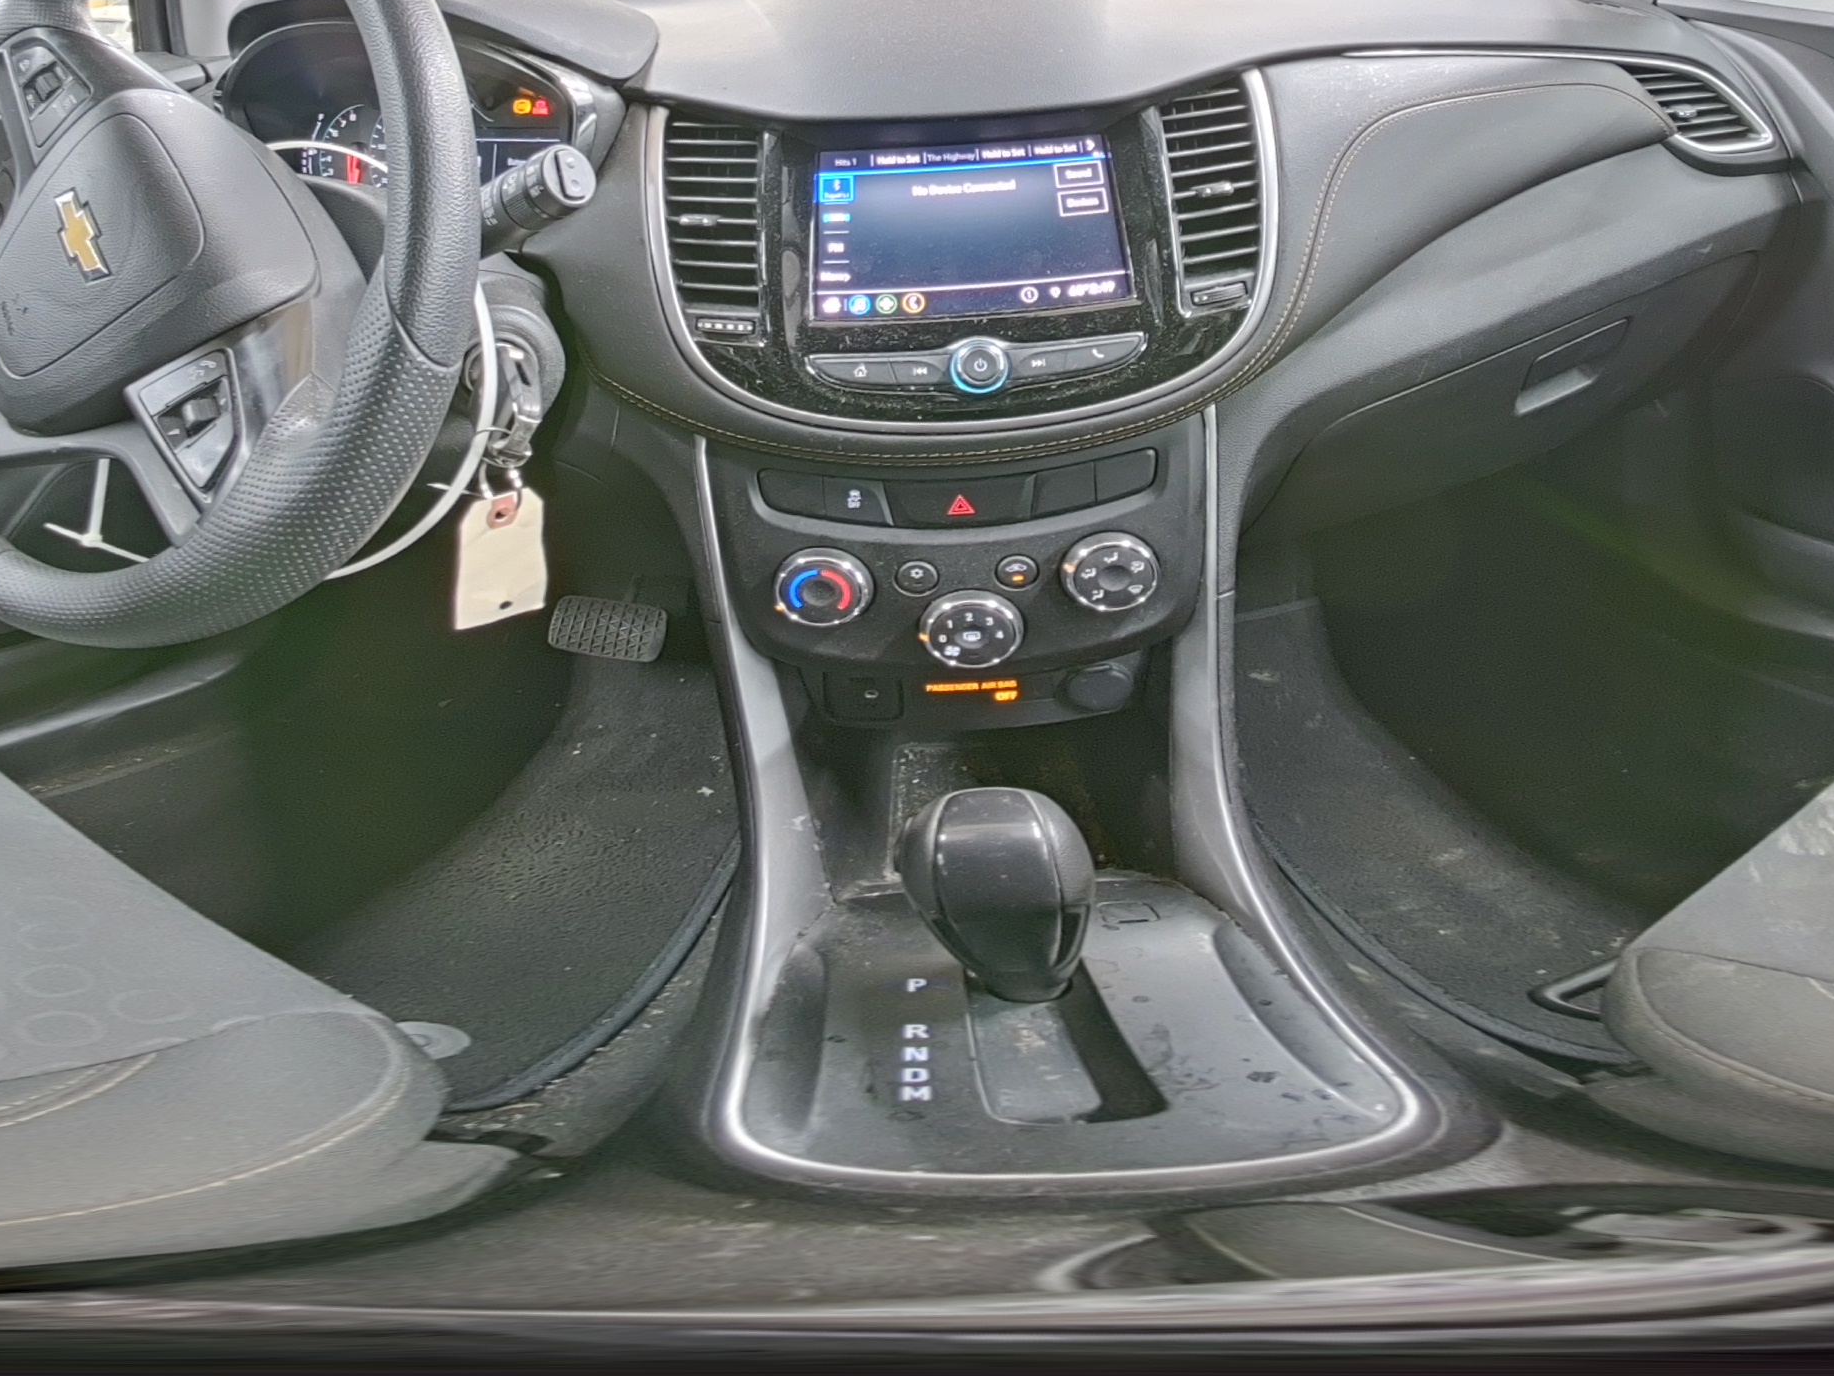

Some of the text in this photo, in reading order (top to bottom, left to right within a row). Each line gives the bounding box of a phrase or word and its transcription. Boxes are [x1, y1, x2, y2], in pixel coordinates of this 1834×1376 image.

[1012, 147, 1026, 157] Set
[1064, 143, 1078, 152] Set
[927, 151, 976, 163] The Highway
[835, 158, 851, 167] Hits
[912, 179, 1016, 197] No Device Connected
[966, 612, 974, 622] 2
[985, 617, 994, 626] 3
[938, 634, 947, 643] 0
[995, 630, 1004, 639] 4
[926, 682, 980, 692] PASSENGER
[995, 690, 1018, 701] OFF
[907, 978, 927, 992] P
[904, 1024, 930, 1039] R
[903, 1046, 929, 1061] N
[902, 1068, 929, 1083] D
[899, 1085, 932, 1102] M
